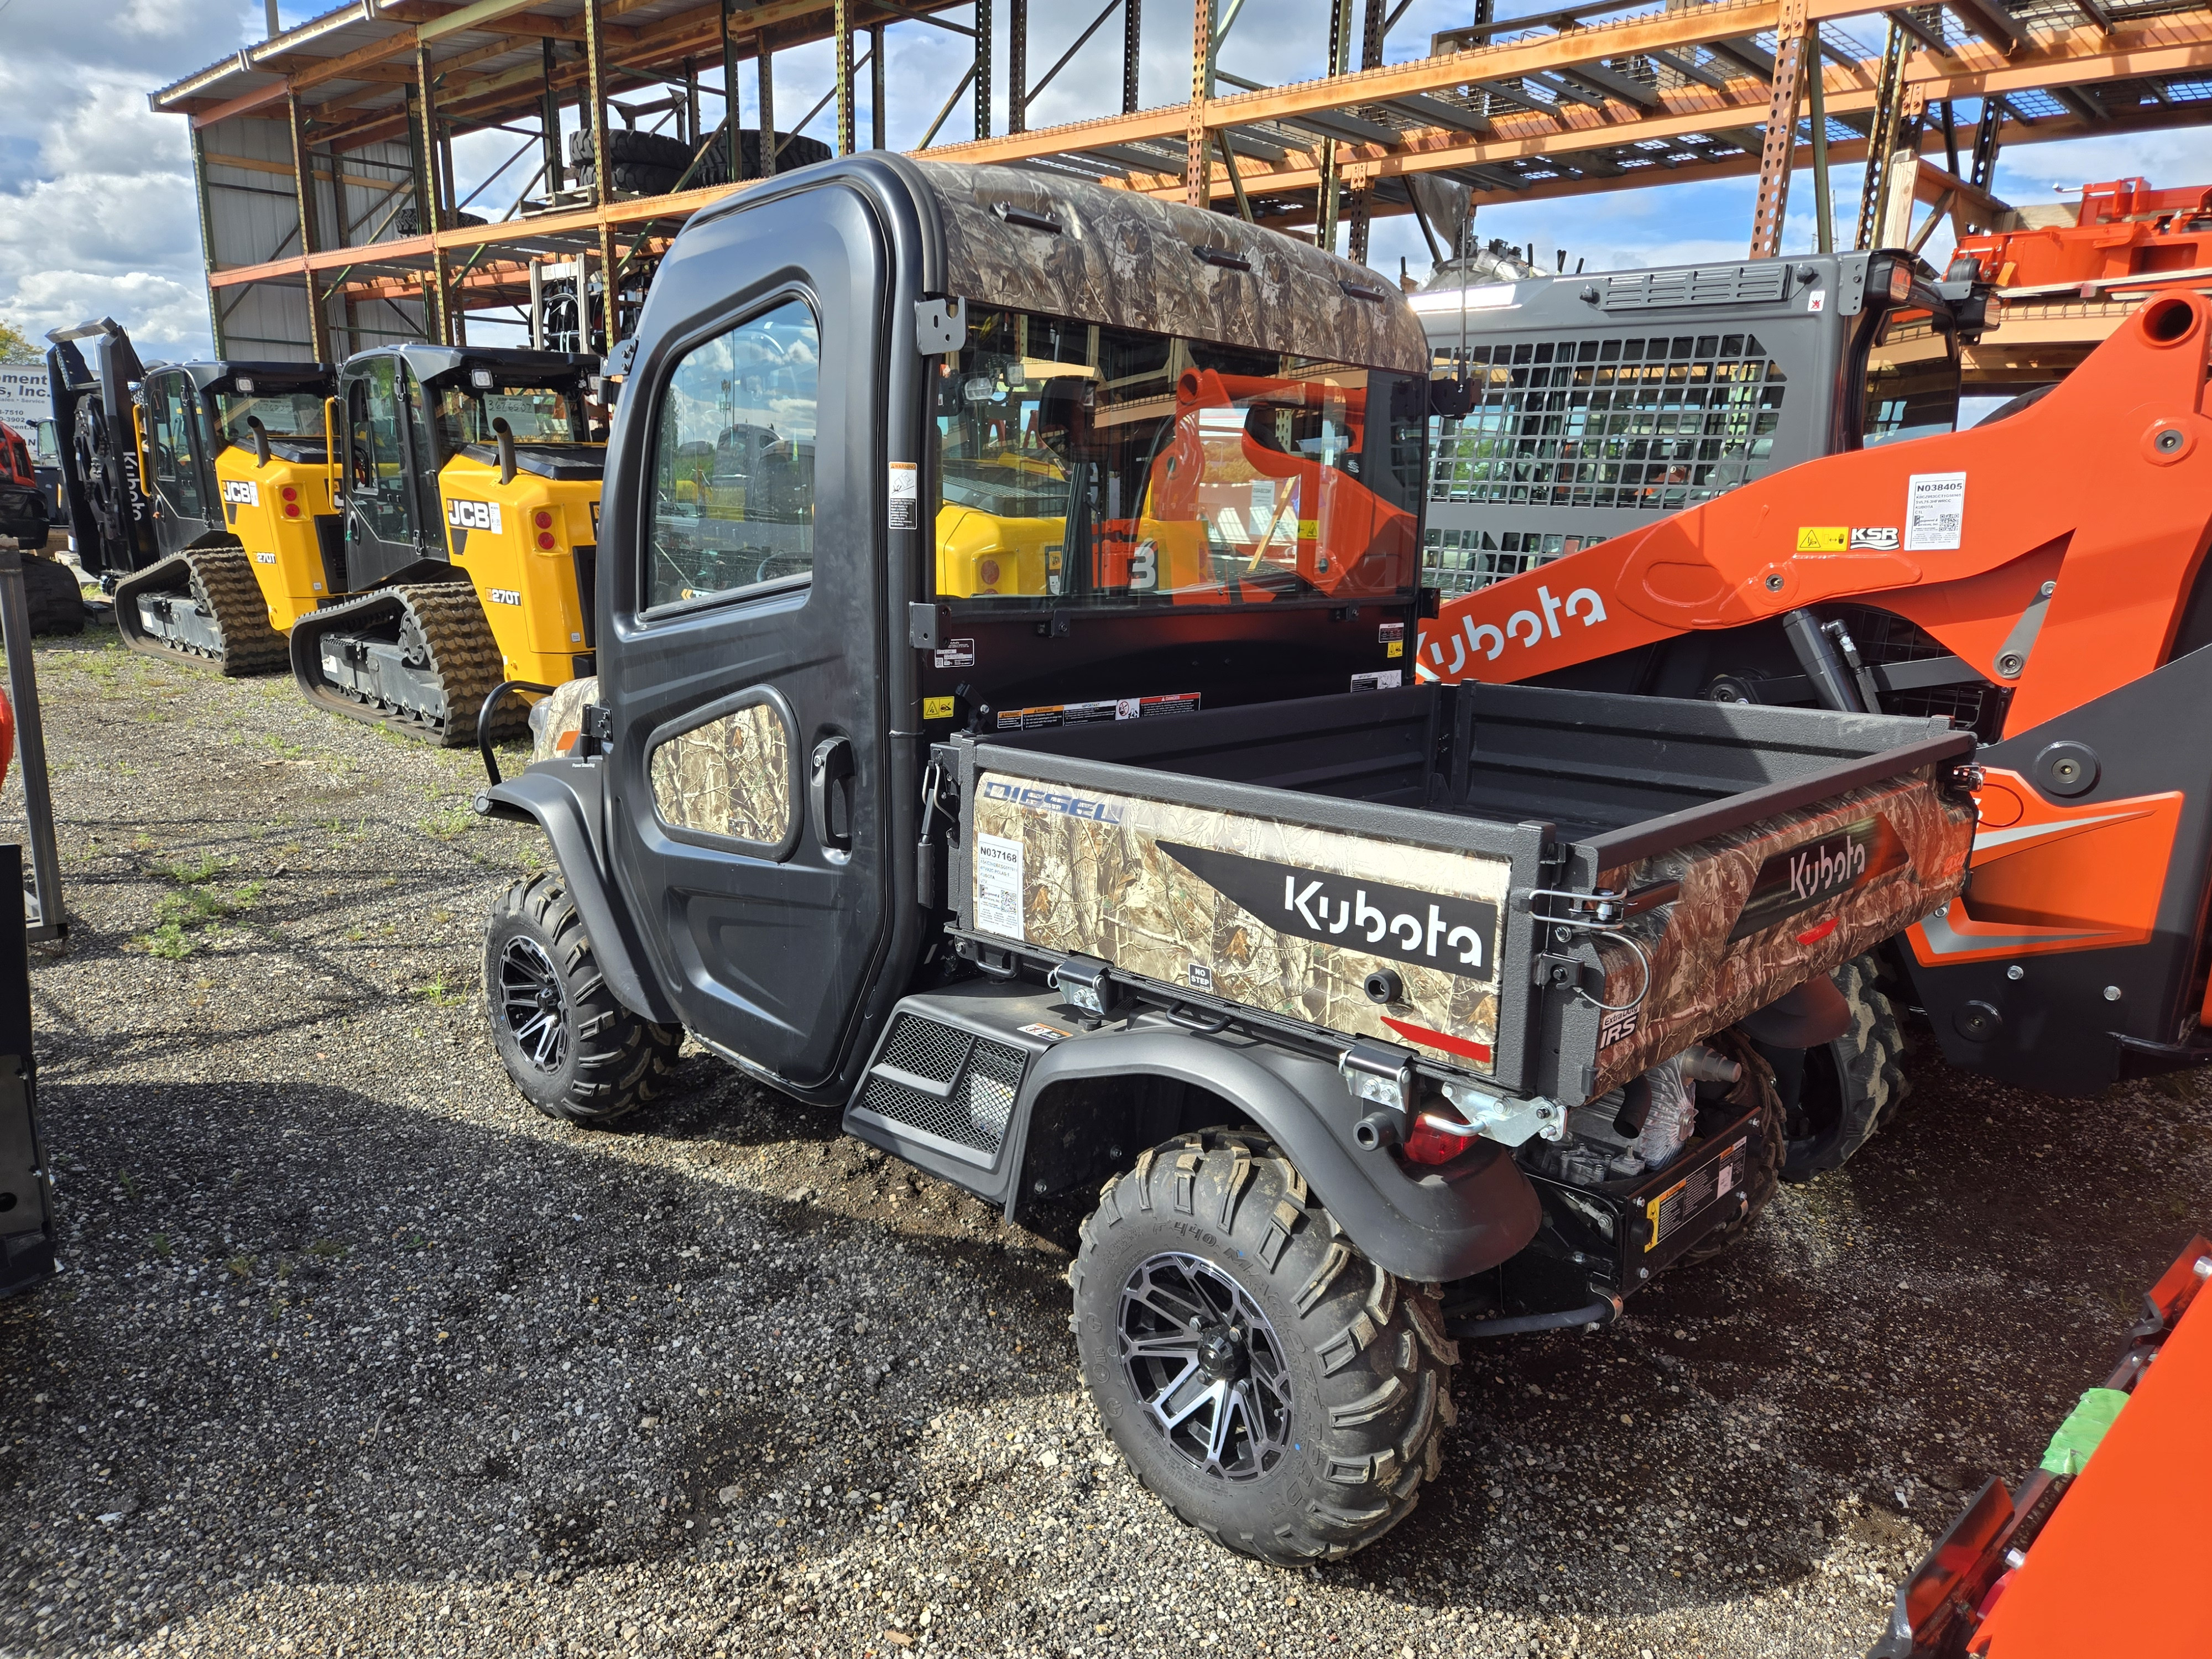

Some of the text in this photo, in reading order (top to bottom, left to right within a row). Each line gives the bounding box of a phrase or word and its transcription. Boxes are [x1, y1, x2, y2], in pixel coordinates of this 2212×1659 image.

[0, 374, 48, 385] ment
[19, 385, 50, 397] Inc.
[223, 482, 251, 503] JCB
[1917, 483, 1962, 492] N038405
[448, 500, 490, 528] JCB
[1851, 528, 1898, 540] KSR
[257, 552, 275, 562] 270T
[492, 588, 520, 605] 270T
[1416, 586, 1607, 680] Kubota
[983, 781, 1124, 825] DIESEL
[980, 846, 1017, 863] N037168
[1791, 835, 1865, 899] Kubota
[1285, 875, 1482, 967] Kubota
[1191, 975, 1209, 985] STEP
[1195, 968, 1206, 977] NO
[1600, 1016, 1637, 1049] IRS
[1173, 1221, 1217, 1246] 440
